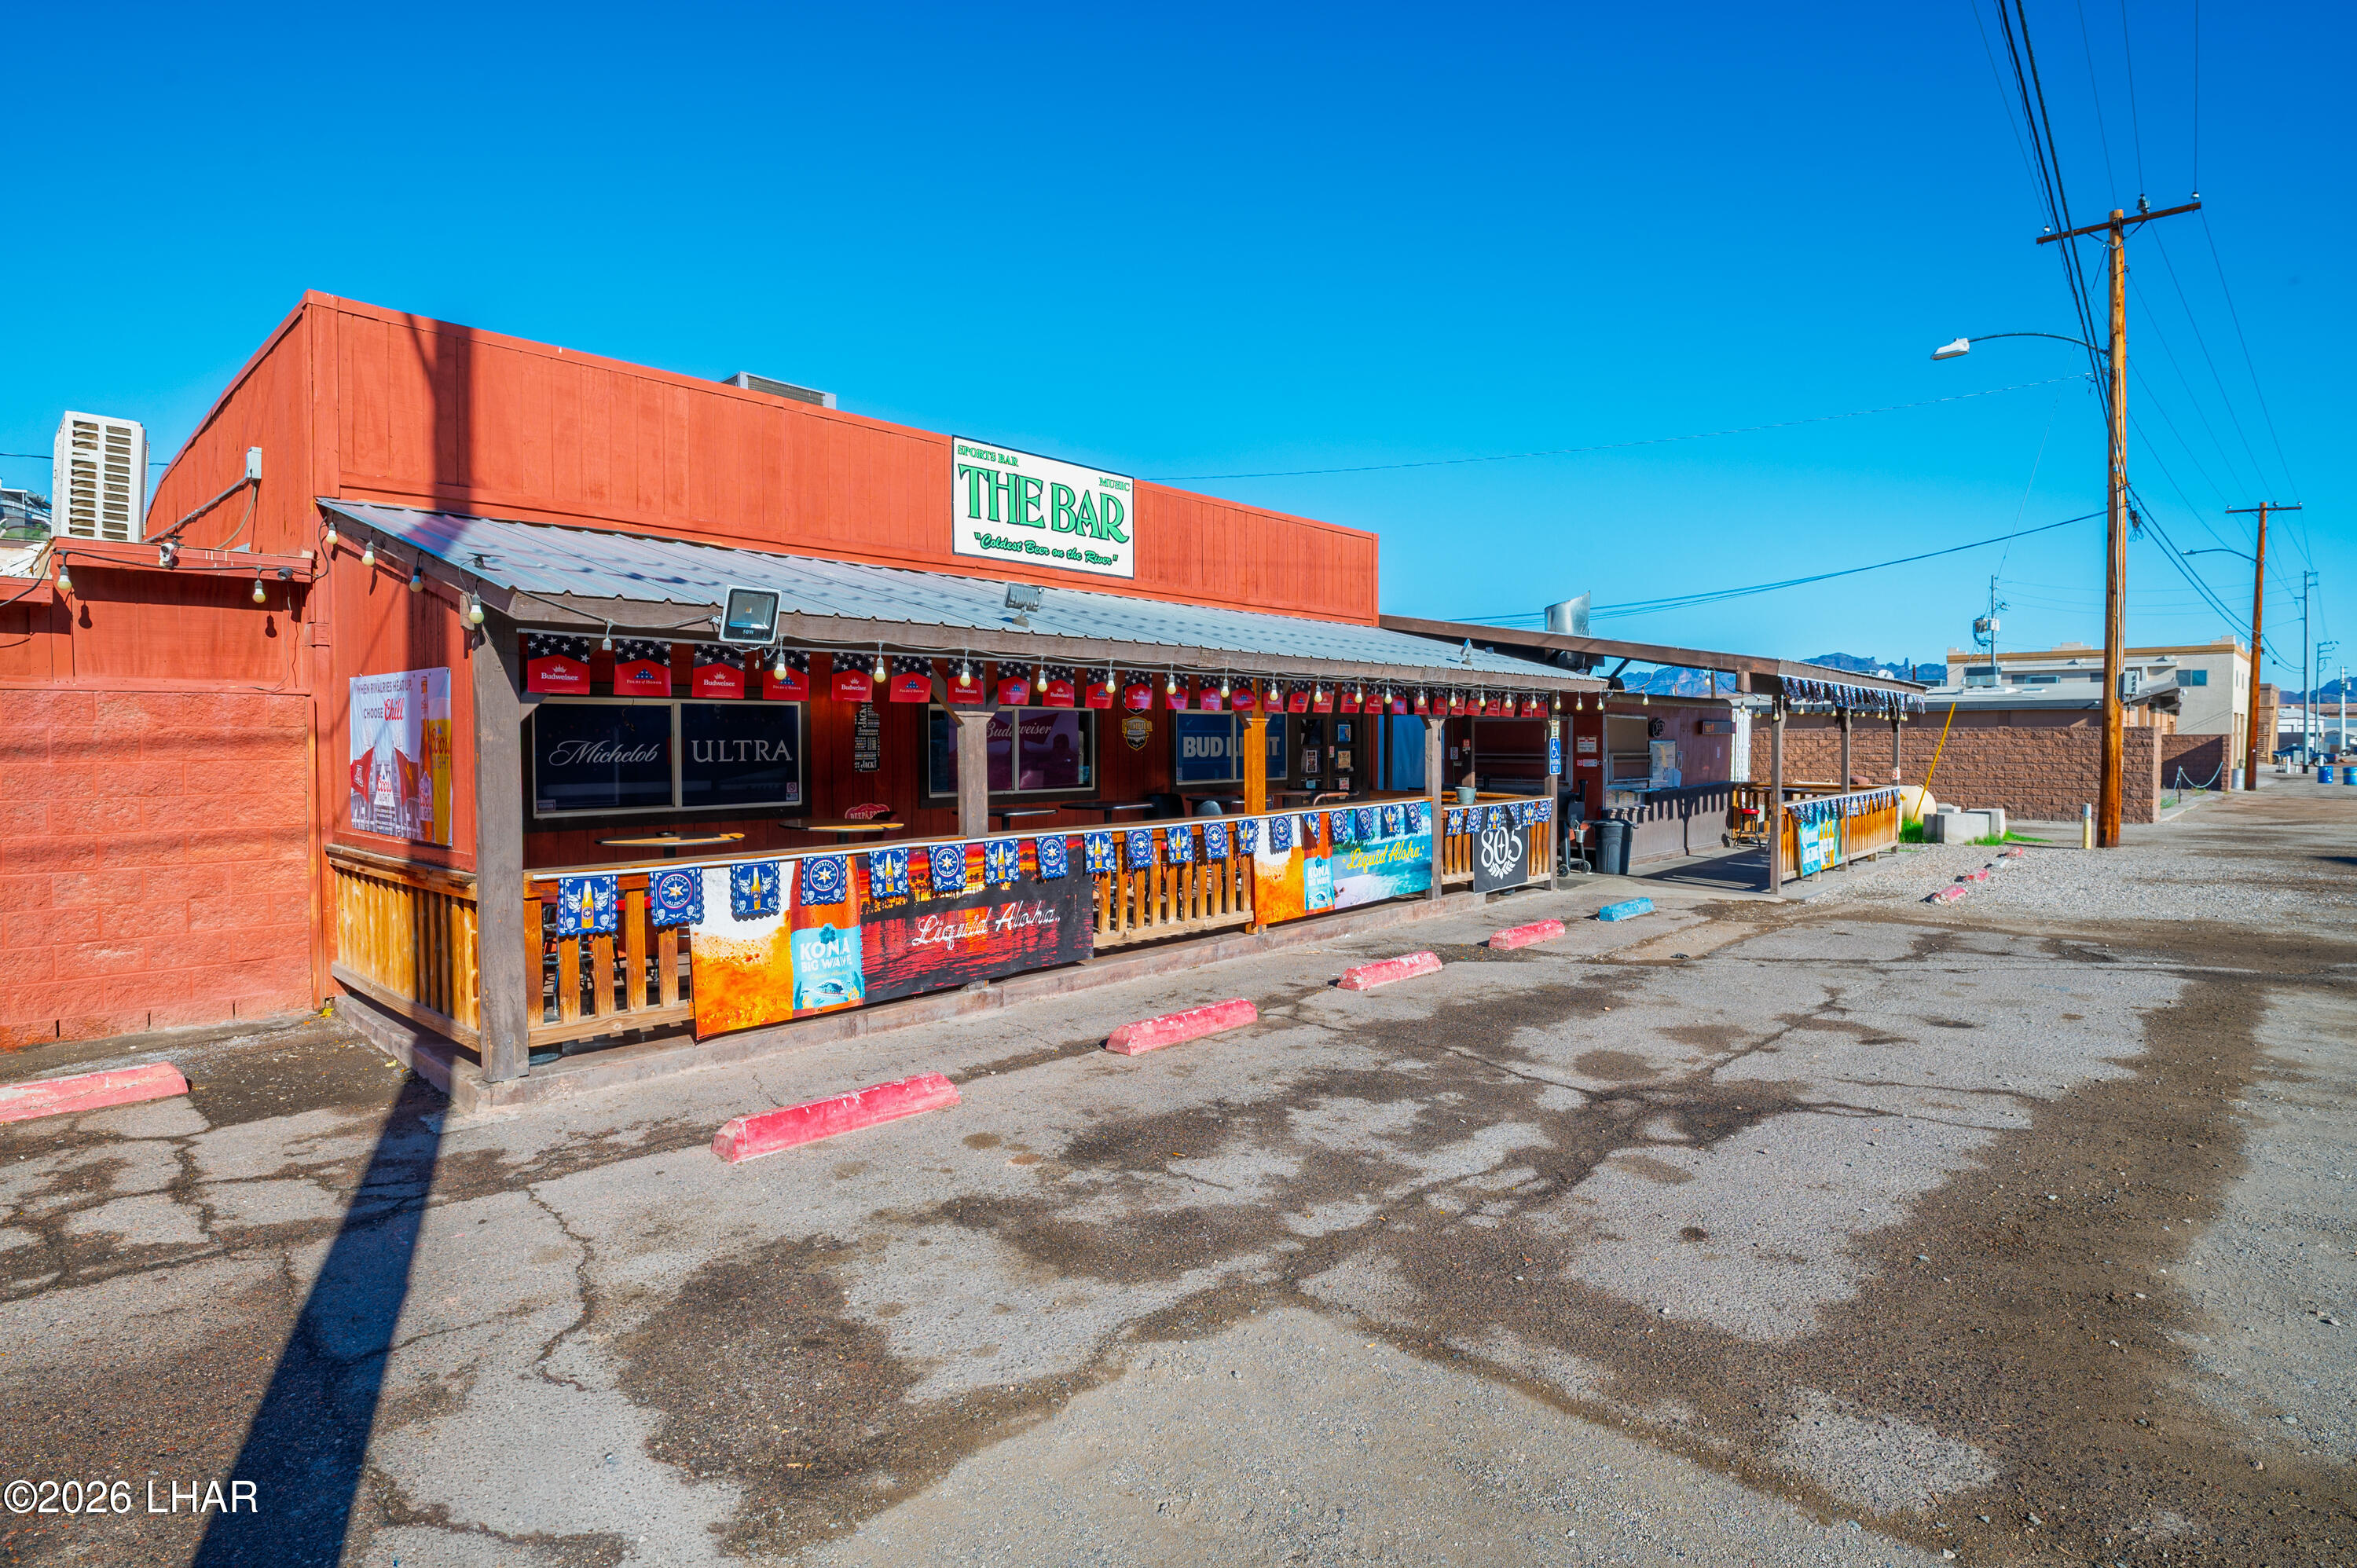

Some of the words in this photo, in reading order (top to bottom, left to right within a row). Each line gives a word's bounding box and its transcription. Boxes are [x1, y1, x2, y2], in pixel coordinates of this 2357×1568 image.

[957, 445, 996, 462] SPORTS
[998, 453, 1019, 467] BAR
[1098, 477, 1131, 492] MUSIC
[958, 463, 1046, 529] THE
[1050, 482, 1130, 544] BAR
[1025, 540, 1050, 556] Beer
[1052, 548, 1065, 559] on
[1066, 548, 1082, 562] the
[357, 683, 369, 694] WHEN
[371, 681, 392, 694] RIVALRIES
[393, 680, 405, 692] HEAT
[363, 707, 383, 719] CHOOSE
[384, 697, 405, 721] Chill
[548, 740, 661, 766] Michelob
[691, 739, 793, 763] ULTRA
[1183, 736, 1224, 757] BUD
[1481, 824, 1523, 868] 805
[1347, 844, 1388, 874] Liquid
[1307, 865, 1329, 877] KONA
[911, 906, 993, 951] Liquid
[799, 936, 851, 962] KONA
[801, 959, 819, 973] BIG
[821, 954, 852, 969] WAVE
